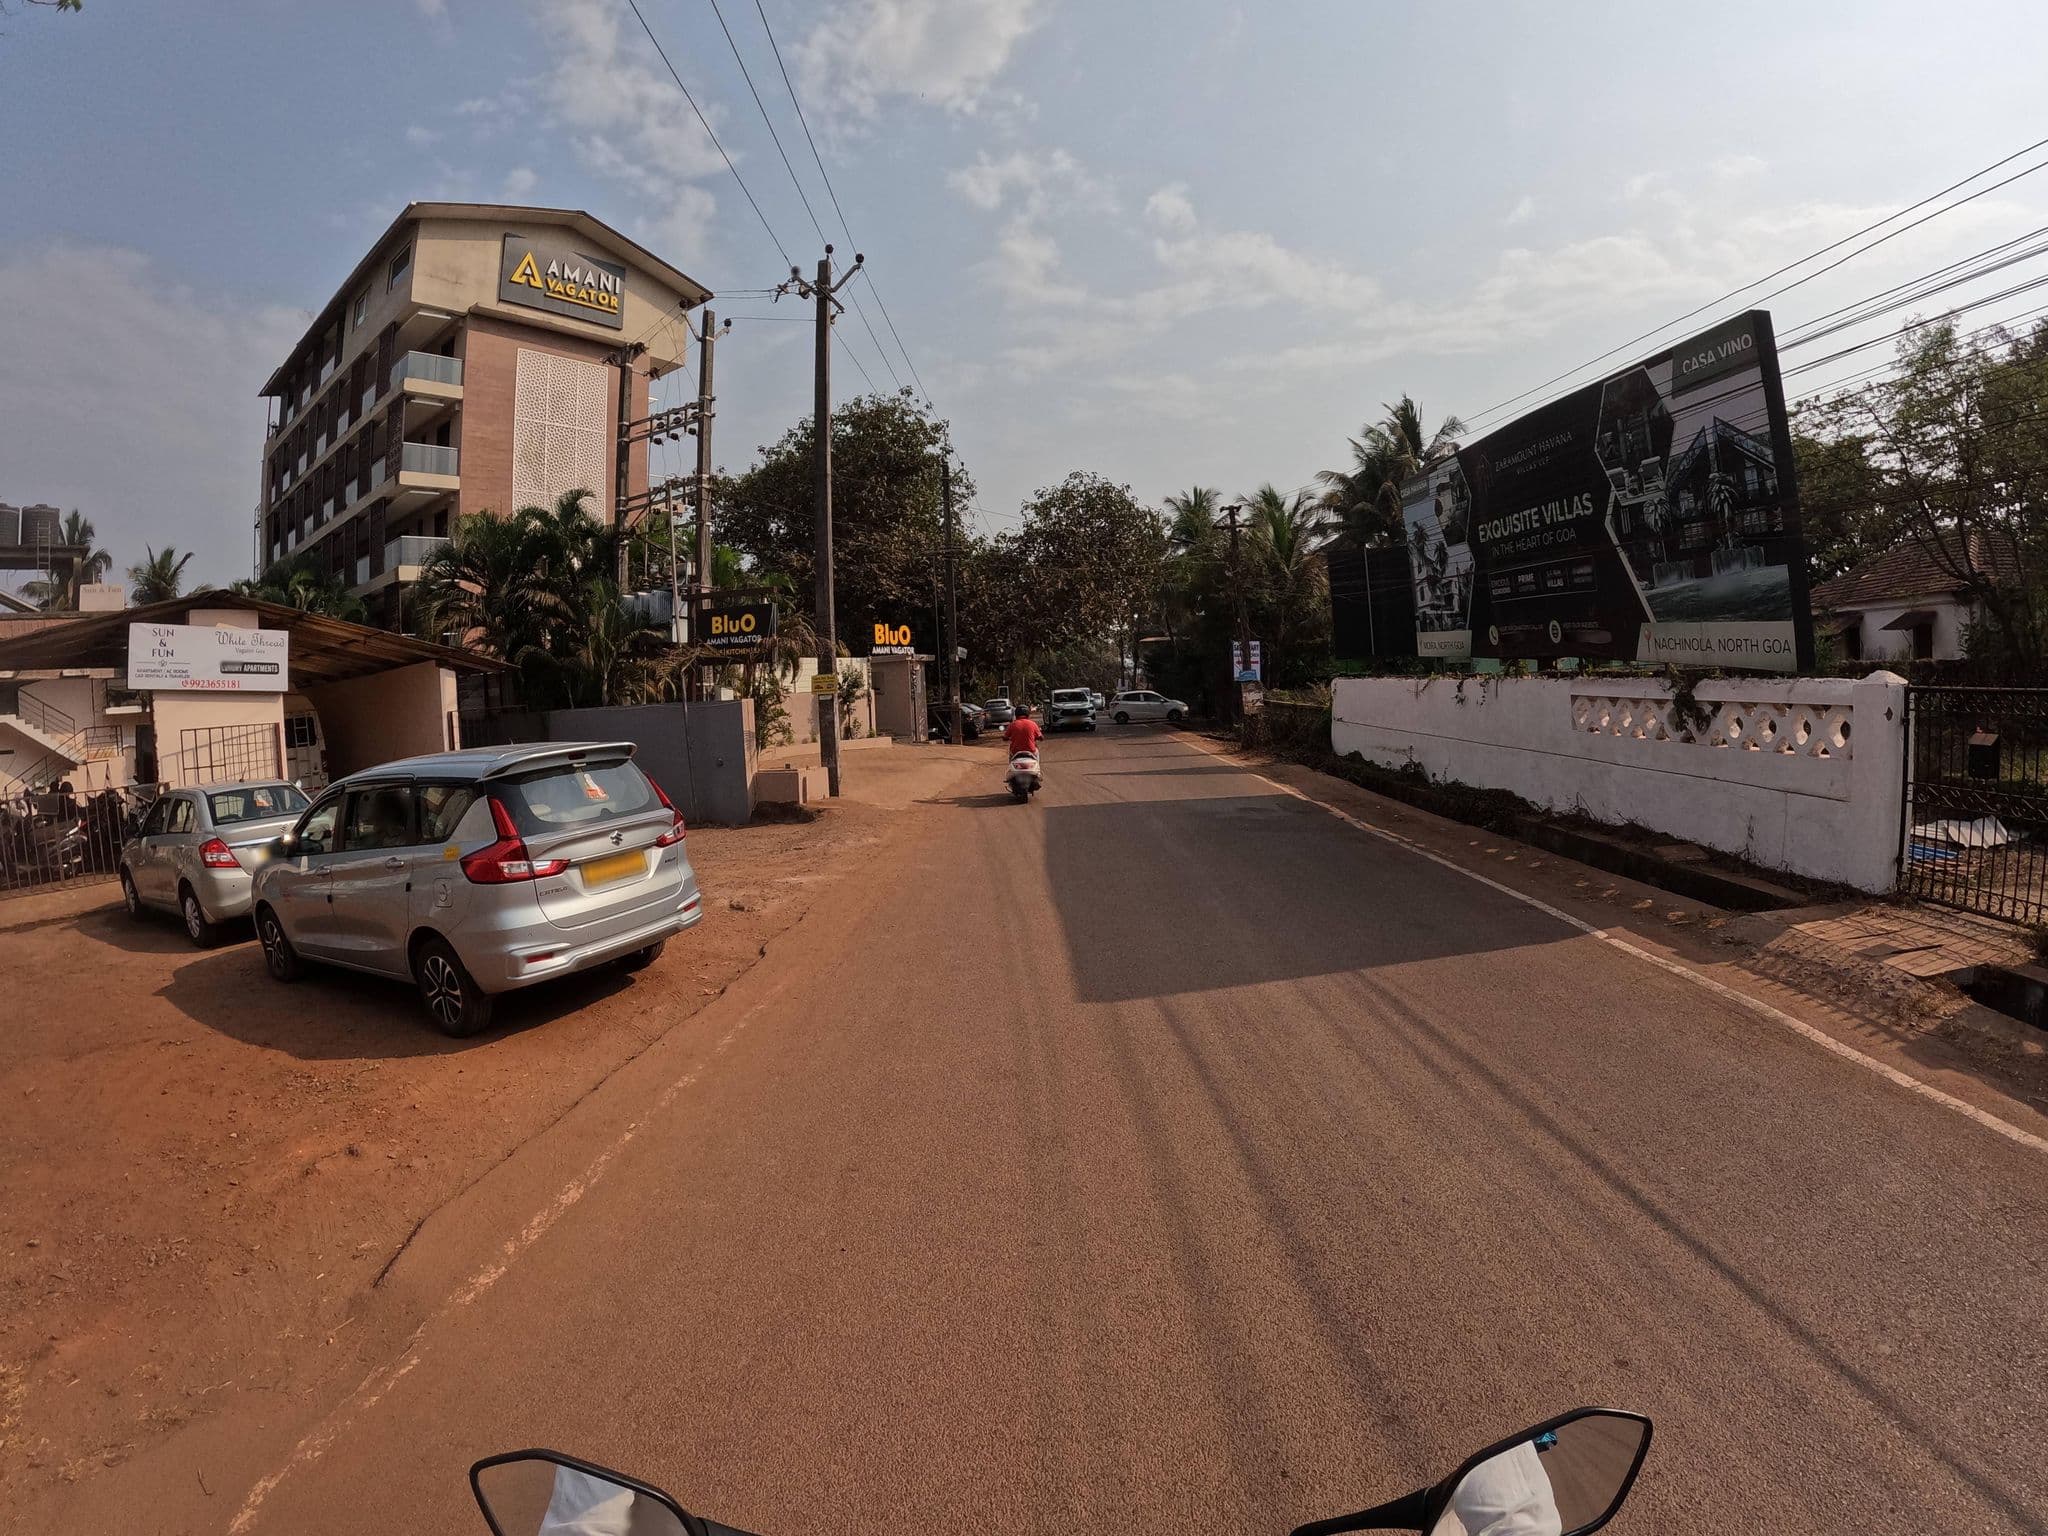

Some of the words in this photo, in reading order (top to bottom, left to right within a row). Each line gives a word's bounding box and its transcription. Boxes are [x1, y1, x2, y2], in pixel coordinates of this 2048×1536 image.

[546, 259, 621, 294] AMANI
[546, 278, 618, 308] VAGATOR
[1683, 350, 1716, 373] CASA
[1717, 334, 1752, 357] VINO
[1478, 507, 1540, 543] EXQUISITE
[1541, 493, 1593, 525] VILLAS
[1500, 541, 1515, 554] THE
[1515, 534, 1543, 551] HEART
[1542, 531, 1554, 546] OF
[1556, 528, 1577, 543] GOA
[711, 613, 756, 634] BluO
[152, 627, 175, 637] SUN
[215, 631, 247, 646] White
[250, 632, 285, 648] Thread
[874, 623, 911, 645] BluO
[159, 639, 167, 647] &
[706, 637, 729, 645] AMANI
[1718, 638, 1759, 653] NORTH
[1762, 638, 1792, 654] GOA
[152, 648, 174, 658] FUN
[872, 646, 890, 654] AMANI
[891, 646, 915, 655] VAGATOR
[243, 664, 279, 673] APARTMENTS
[190, 680, 241, 689] 9923655181
